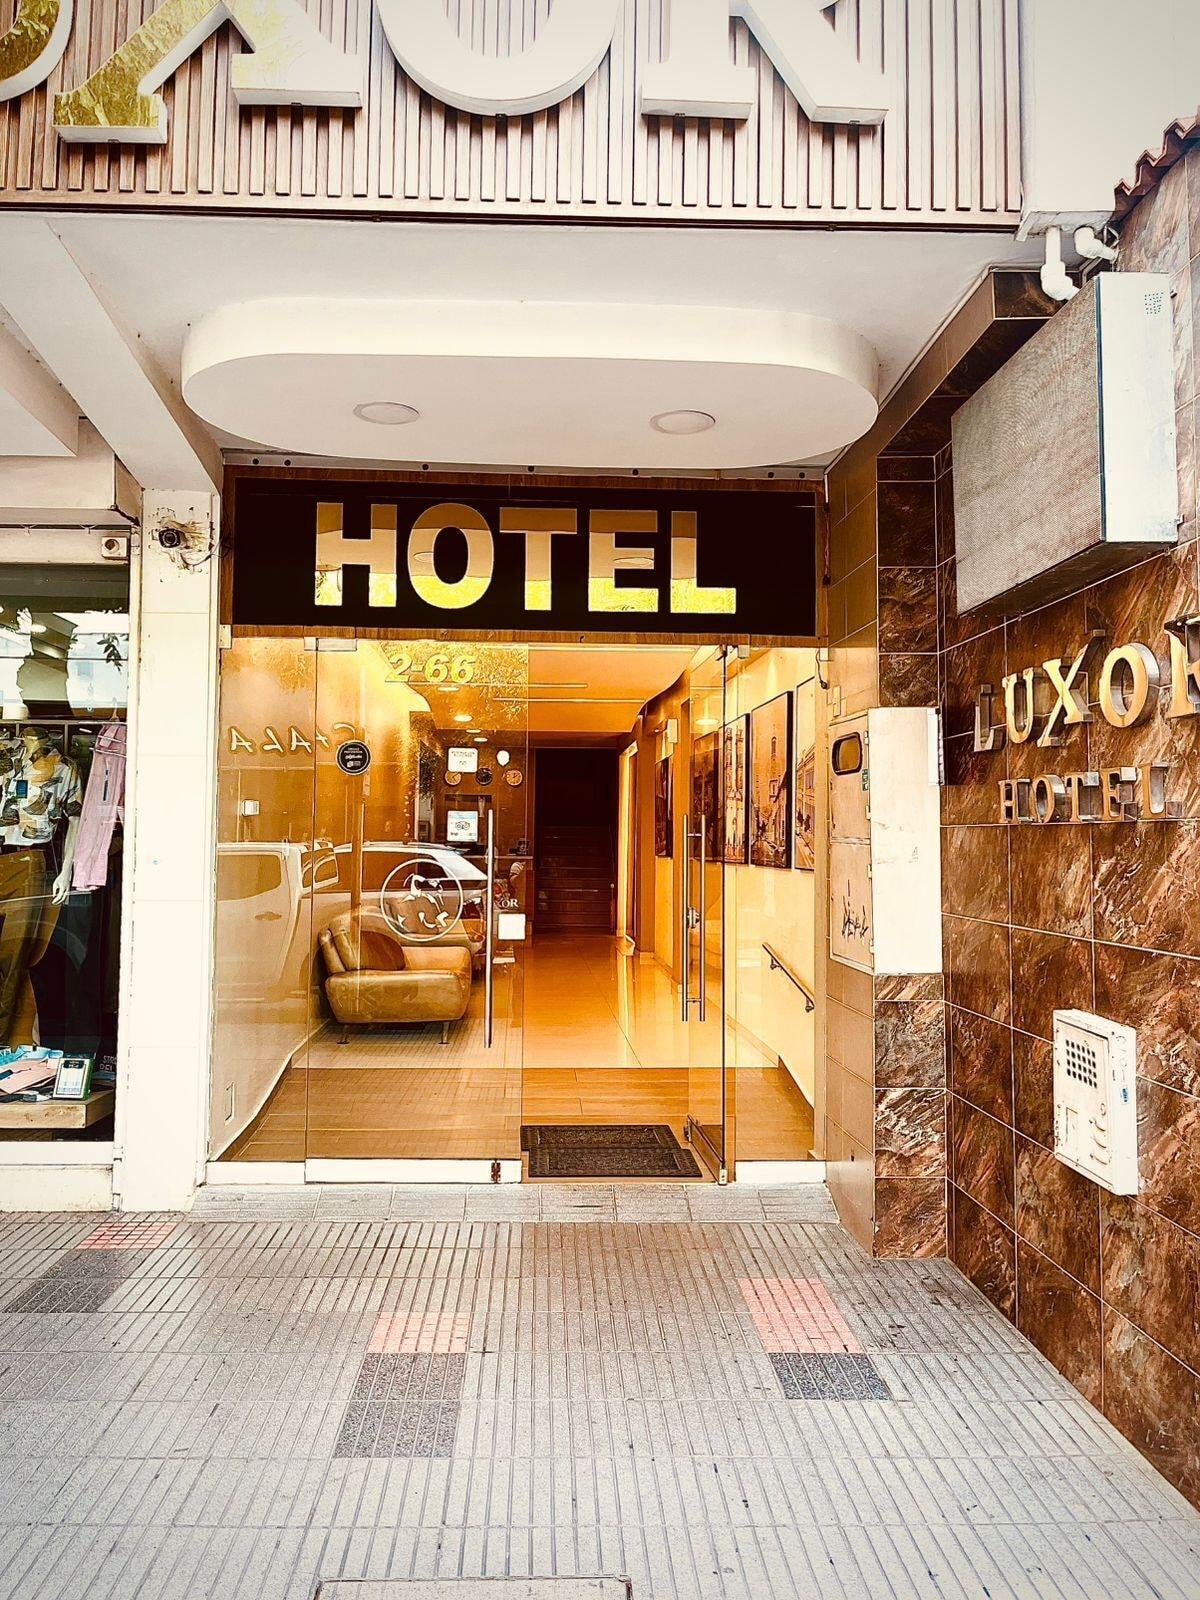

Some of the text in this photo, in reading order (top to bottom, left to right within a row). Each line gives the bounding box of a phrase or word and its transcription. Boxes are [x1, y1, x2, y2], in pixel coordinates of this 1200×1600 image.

[314, 502, 737, 614] HOTEL
[384, 653, 478, 683] 2-66
[998, 762, 1184, 825] HOTEL
